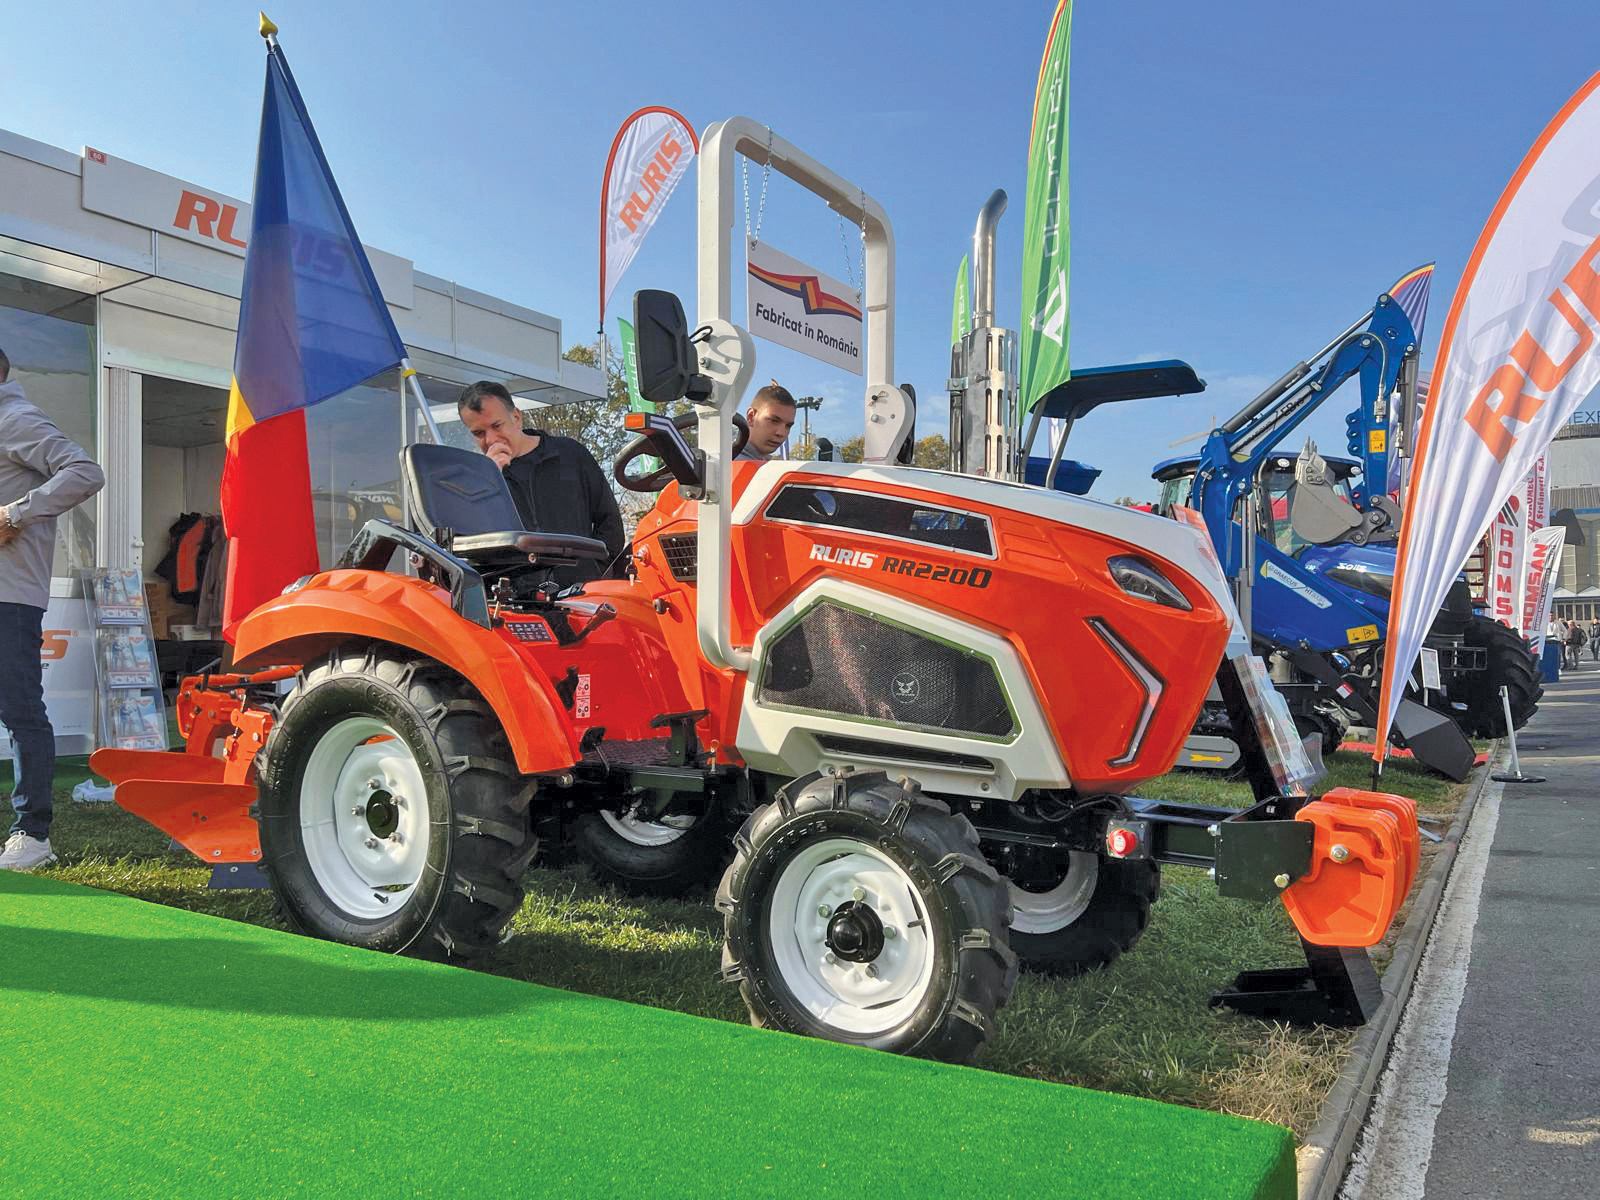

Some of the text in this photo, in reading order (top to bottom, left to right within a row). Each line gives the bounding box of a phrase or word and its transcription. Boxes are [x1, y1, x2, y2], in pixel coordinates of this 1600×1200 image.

[618, 131, 683, 234] RURIS
[755, 302, 859, 358] Fabricat în România
[809, 543, 993, 589] RURIS RR2200
